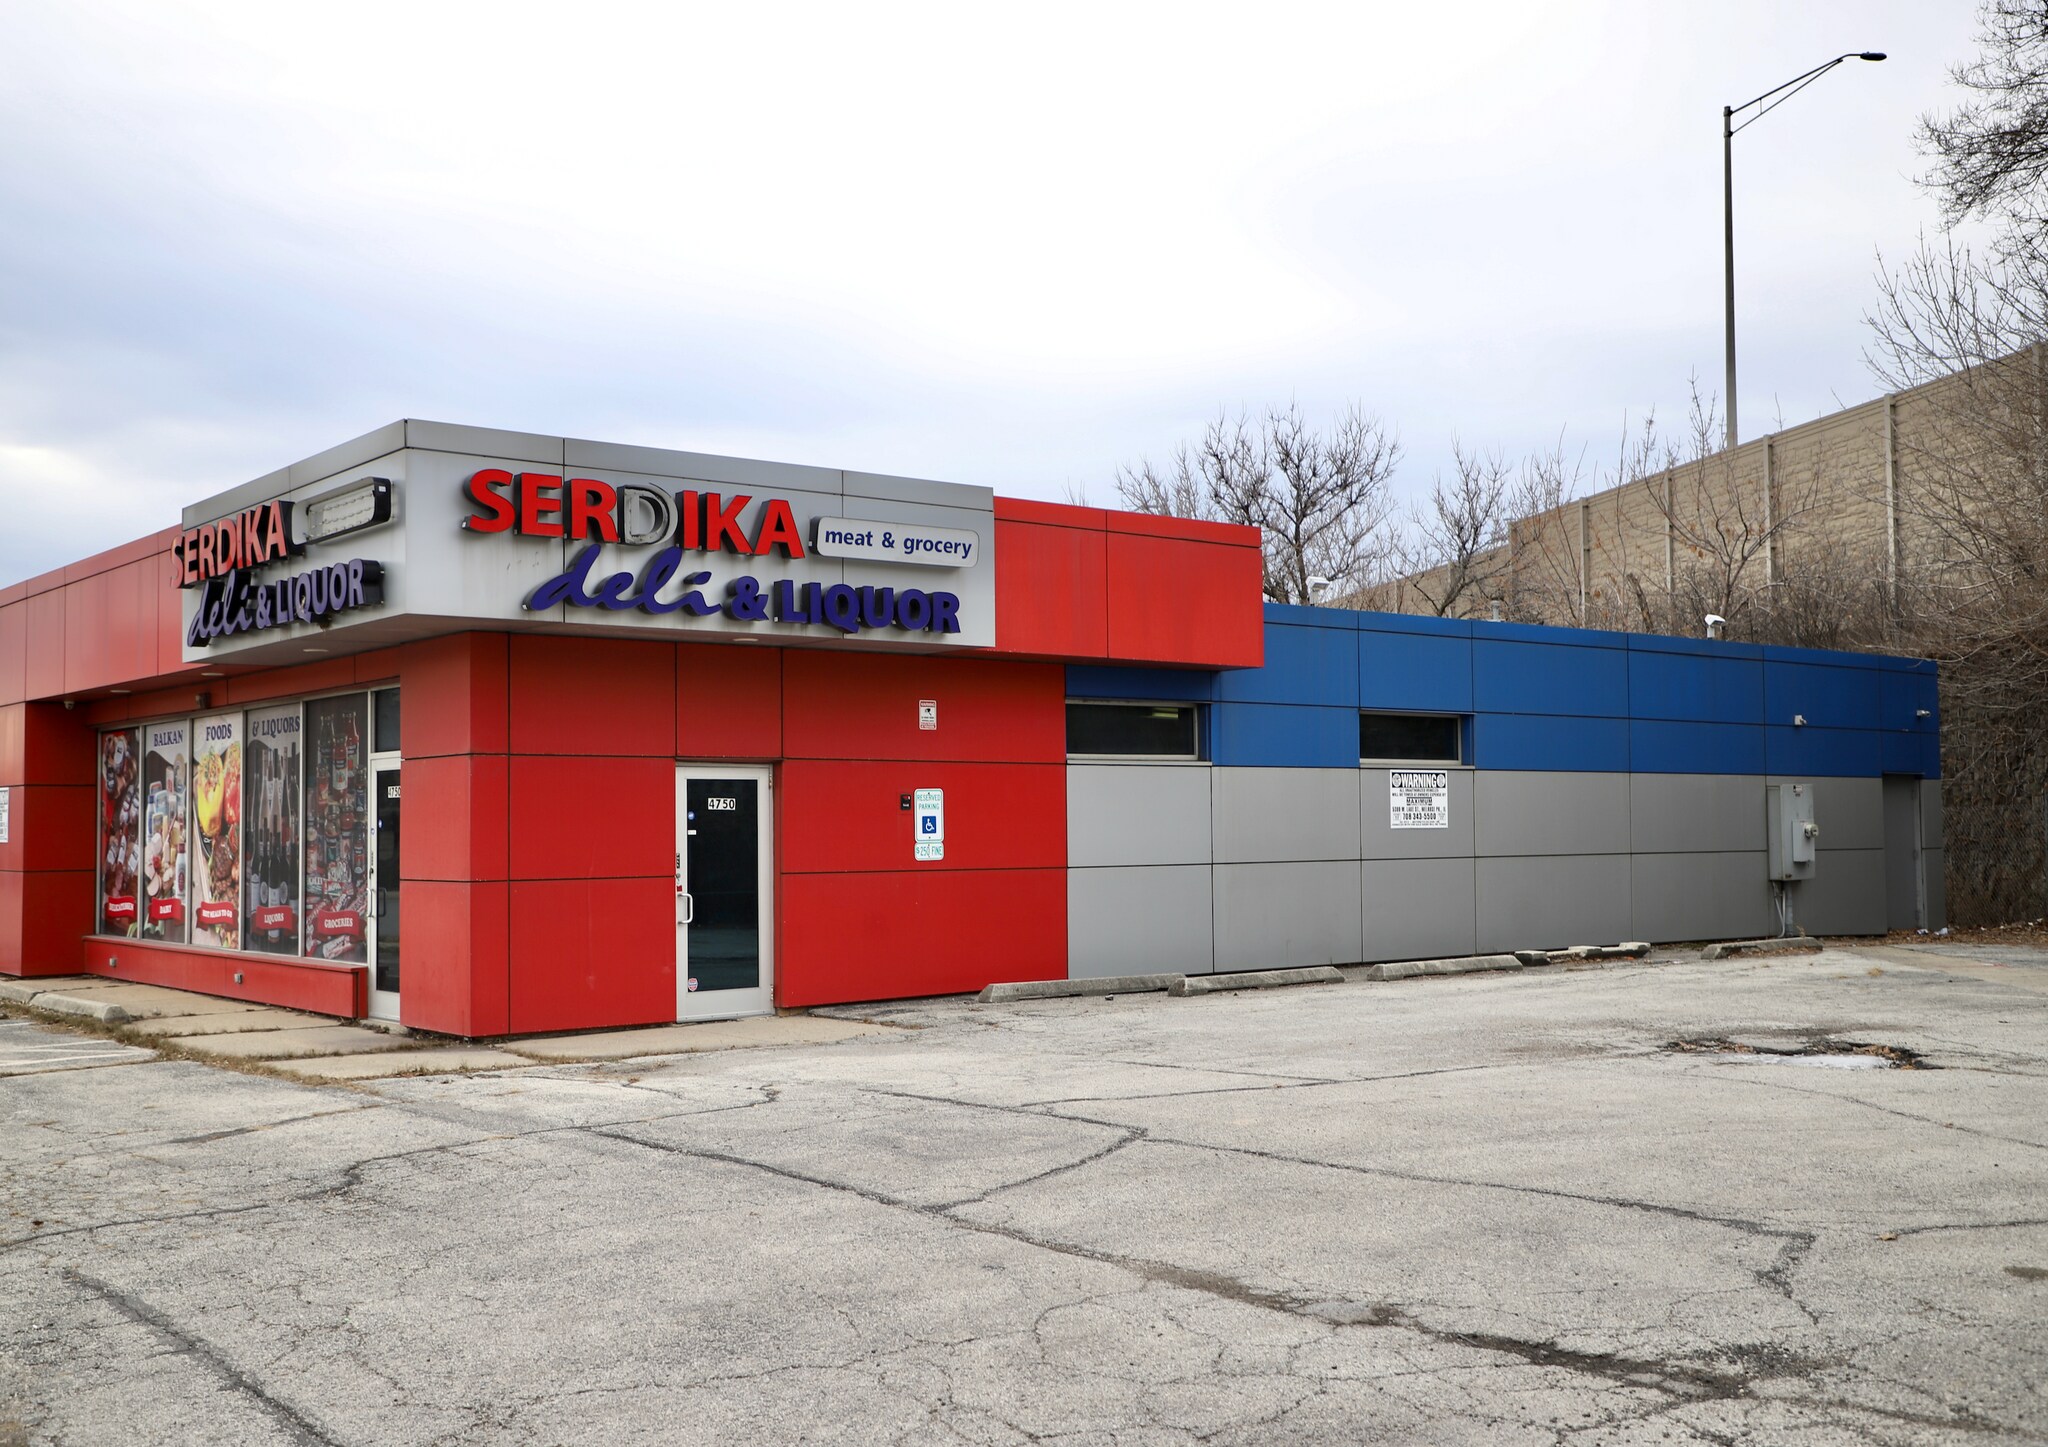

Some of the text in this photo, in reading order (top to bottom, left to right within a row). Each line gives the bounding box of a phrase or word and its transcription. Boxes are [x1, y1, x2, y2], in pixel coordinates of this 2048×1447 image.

[465, 468, 805, 559] SERDIKA
[170, 500, 287, 589] SERDIKA
[825, 530, 972, 559] meat & grocery
[526, 544, 960, 633] deli & LIQUOR
[187, 558, 364, 647] deli & LIQUOR
[205, 724, 232, 741] FOODS
[252, 715, 300, 738] & LIQUORS
[153, 730, 183, 747] BALKAN
[1401, 773, 1437, 788] WARNING
[708, 799, 735, 809] 4750
[931, 846, 942, 856] FINE
[264, 913, 284, 925] LIQUORS
[324, 917, 353, 929] GROCERIES
